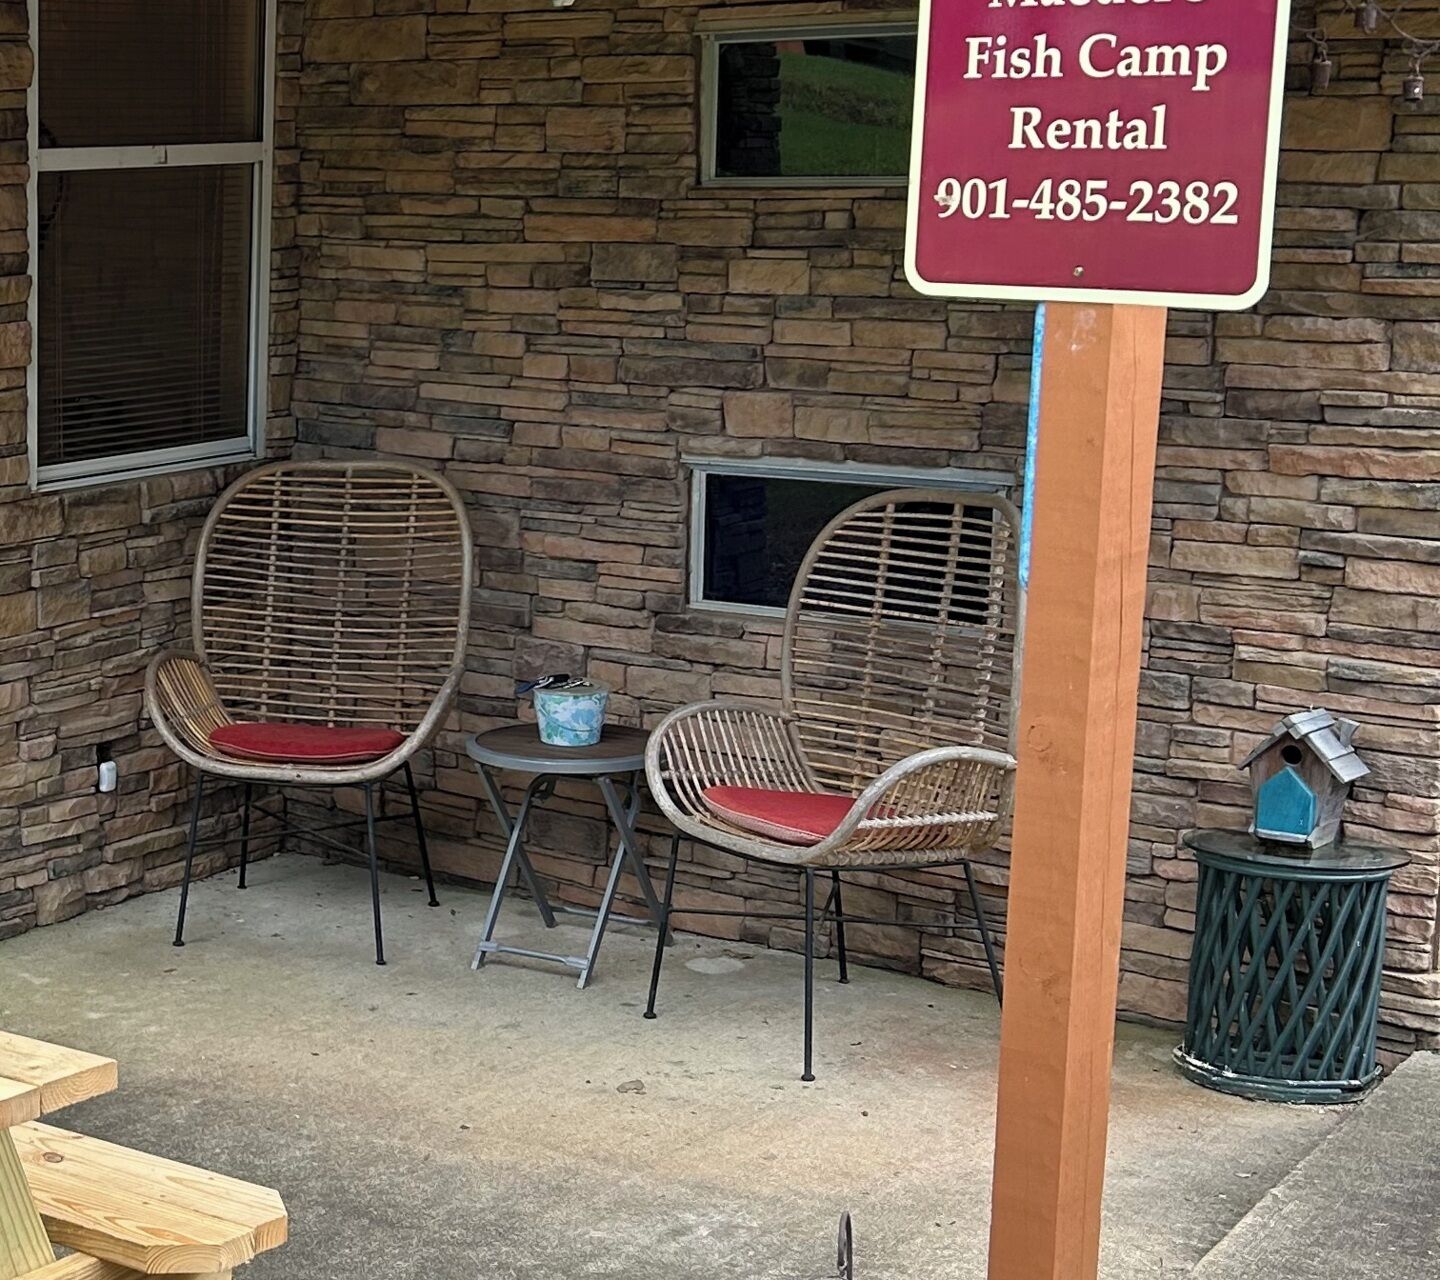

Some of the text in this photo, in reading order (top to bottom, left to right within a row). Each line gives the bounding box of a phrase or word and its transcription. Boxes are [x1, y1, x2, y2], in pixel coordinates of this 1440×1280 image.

[962, 32, 1229, 92] Fish Camp
[1007, 104, 1169, 151] Rental
[934, 176, 1240, 226] 901-485-2382
